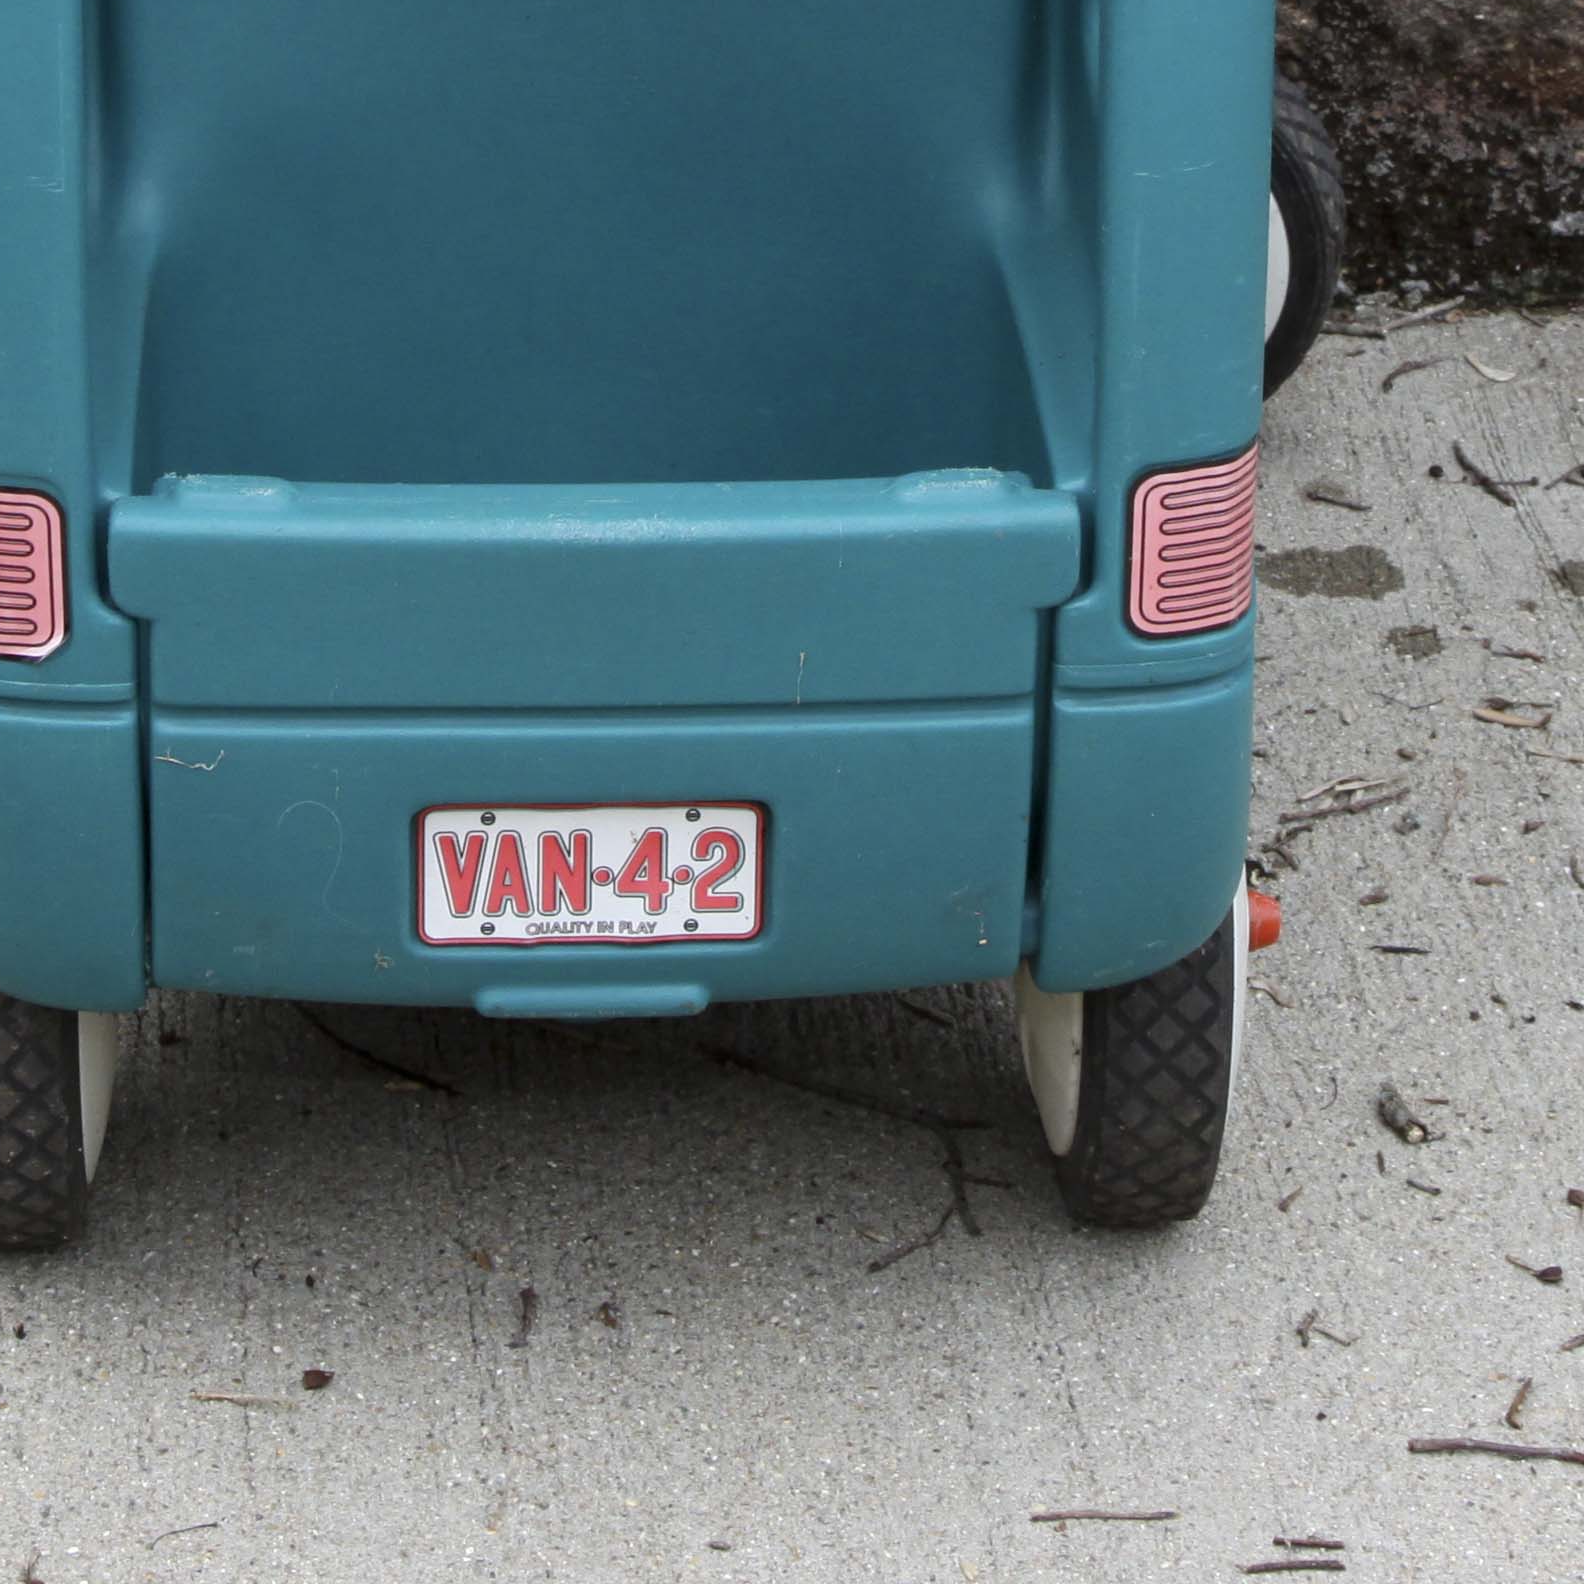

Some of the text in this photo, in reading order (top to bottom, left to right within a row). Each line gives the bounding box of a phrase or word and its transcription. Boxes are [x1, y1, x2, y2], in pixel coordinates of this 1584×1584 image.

[525, 920, 658, 936] QUALITY IN PLAY
